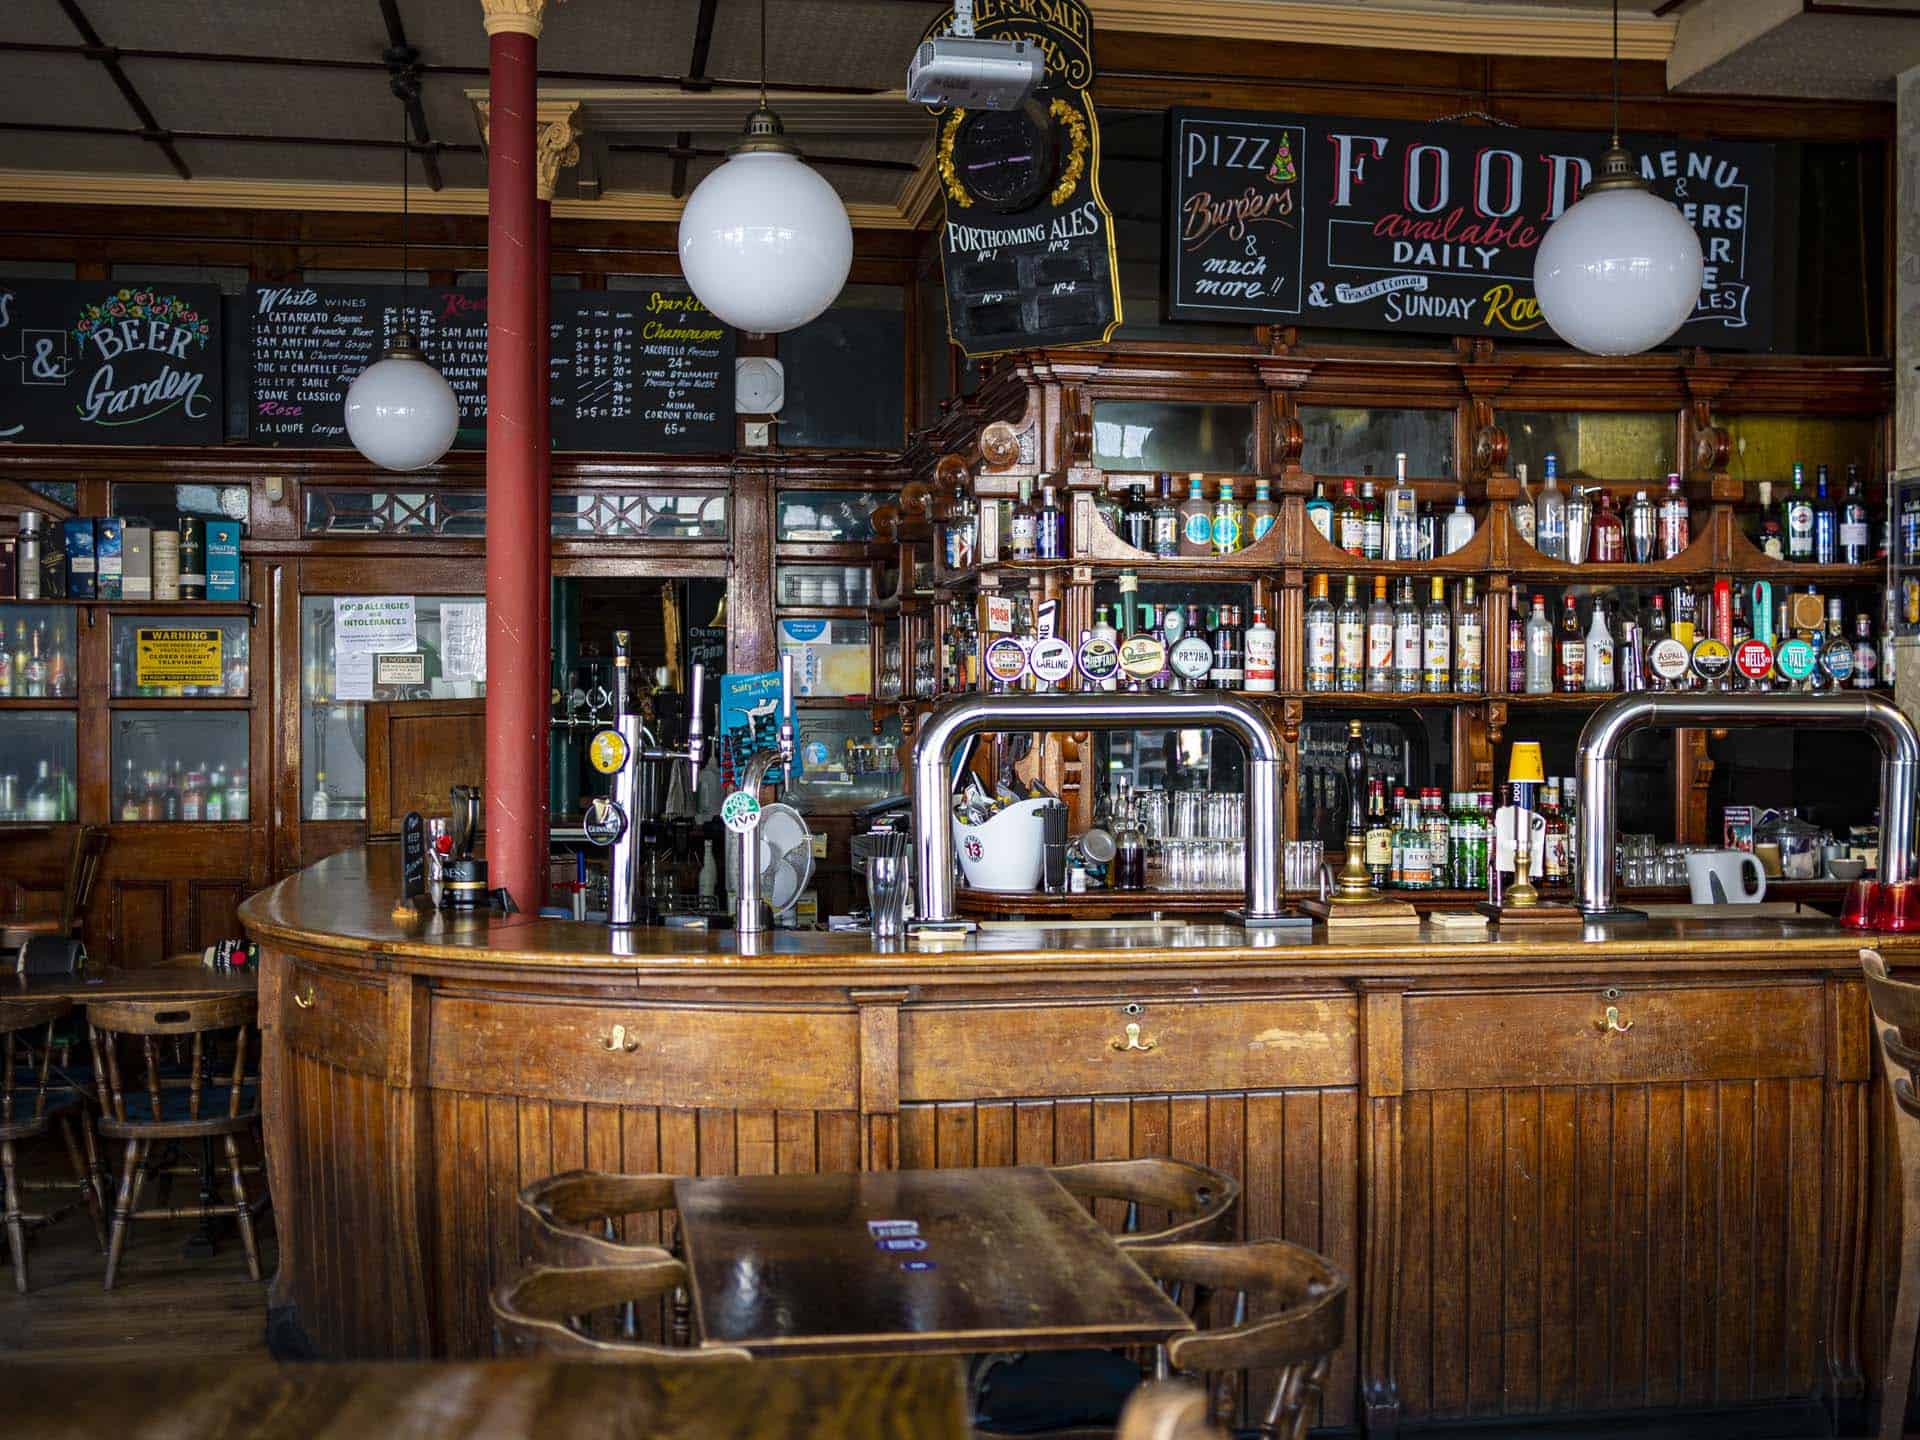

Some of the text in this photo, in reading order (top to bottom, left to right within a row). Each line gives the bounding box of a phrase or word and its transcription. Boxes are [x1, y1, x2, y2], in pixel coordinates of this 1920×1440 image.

[1674, 177, 1689, 197] &
[1183, 187, 1293, 240] Burgers
[947, 201, 1098, 253] FORTHCOMING ALES
[1374, 207, 1541, 248] available
[1245, 235, 1258, 256] &
[1393, 241, 1500, 270] DAILY
[1202, 256, 1267, 276] much
[256, 287, 367, 314] White WINES
[1308, 281, 1333, 307] &
[1384, 291, 1477, 323] SUNDAY
[269, 312, 329, 322] CATARRATO
[92, 319, 193, 360] BEER
[257, 325, 271, 335] LA
[642, 321, 723, 343] Champagne
[32, 338, 66, 378] &
[257, 350, 270, 360] LA
[80, 364, 211, 421] Garden
[257, 390, 341, 401] SOAVE CLASSICO
[260, 424, 272, 433] LA
[365, 602, 410, 610] ALLERGIES
[344, 618, 407, 627] INTOLERANCES
[152, 631, 208, 640] WARNING
[964, 842, 981, 857] 13
